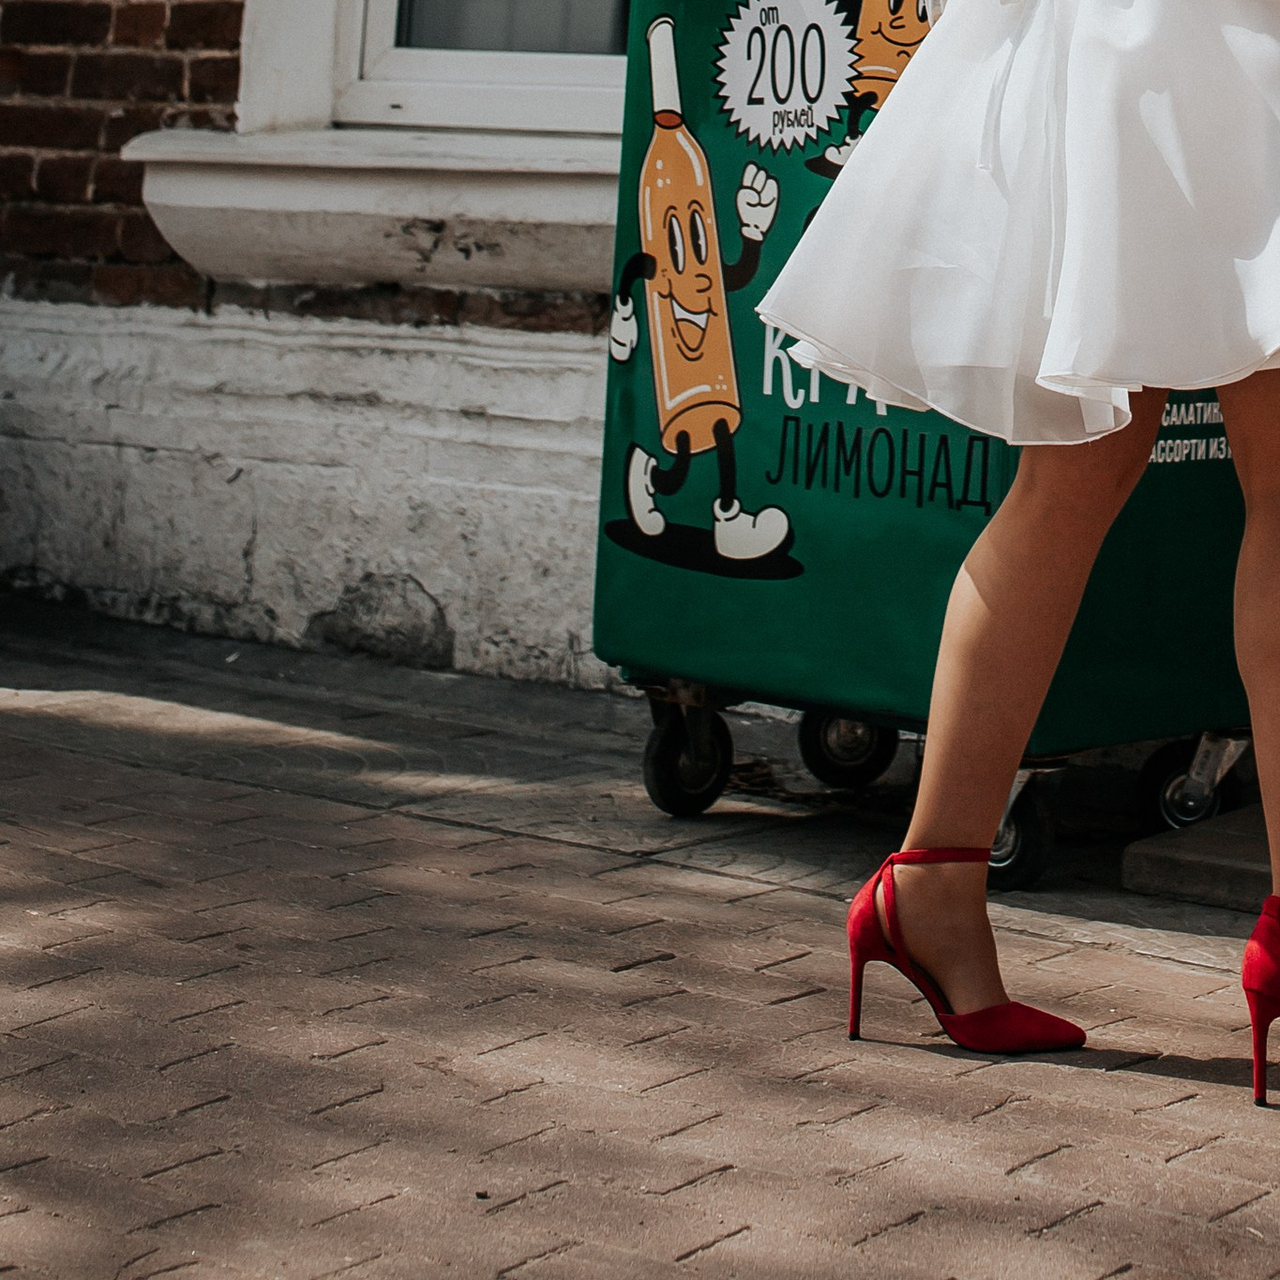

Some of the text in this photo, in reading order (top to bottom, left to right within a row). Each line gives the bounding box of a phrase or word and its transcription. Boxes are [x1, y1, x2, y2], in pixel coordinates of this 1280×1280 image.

[747, 23, 825, 106] 200
[765, 415, 991, 517] ЛИМОНАД
[1148, 439, 1206, 463] АССОРТИ
[1208, 437, 1227, 459] ИЗ
